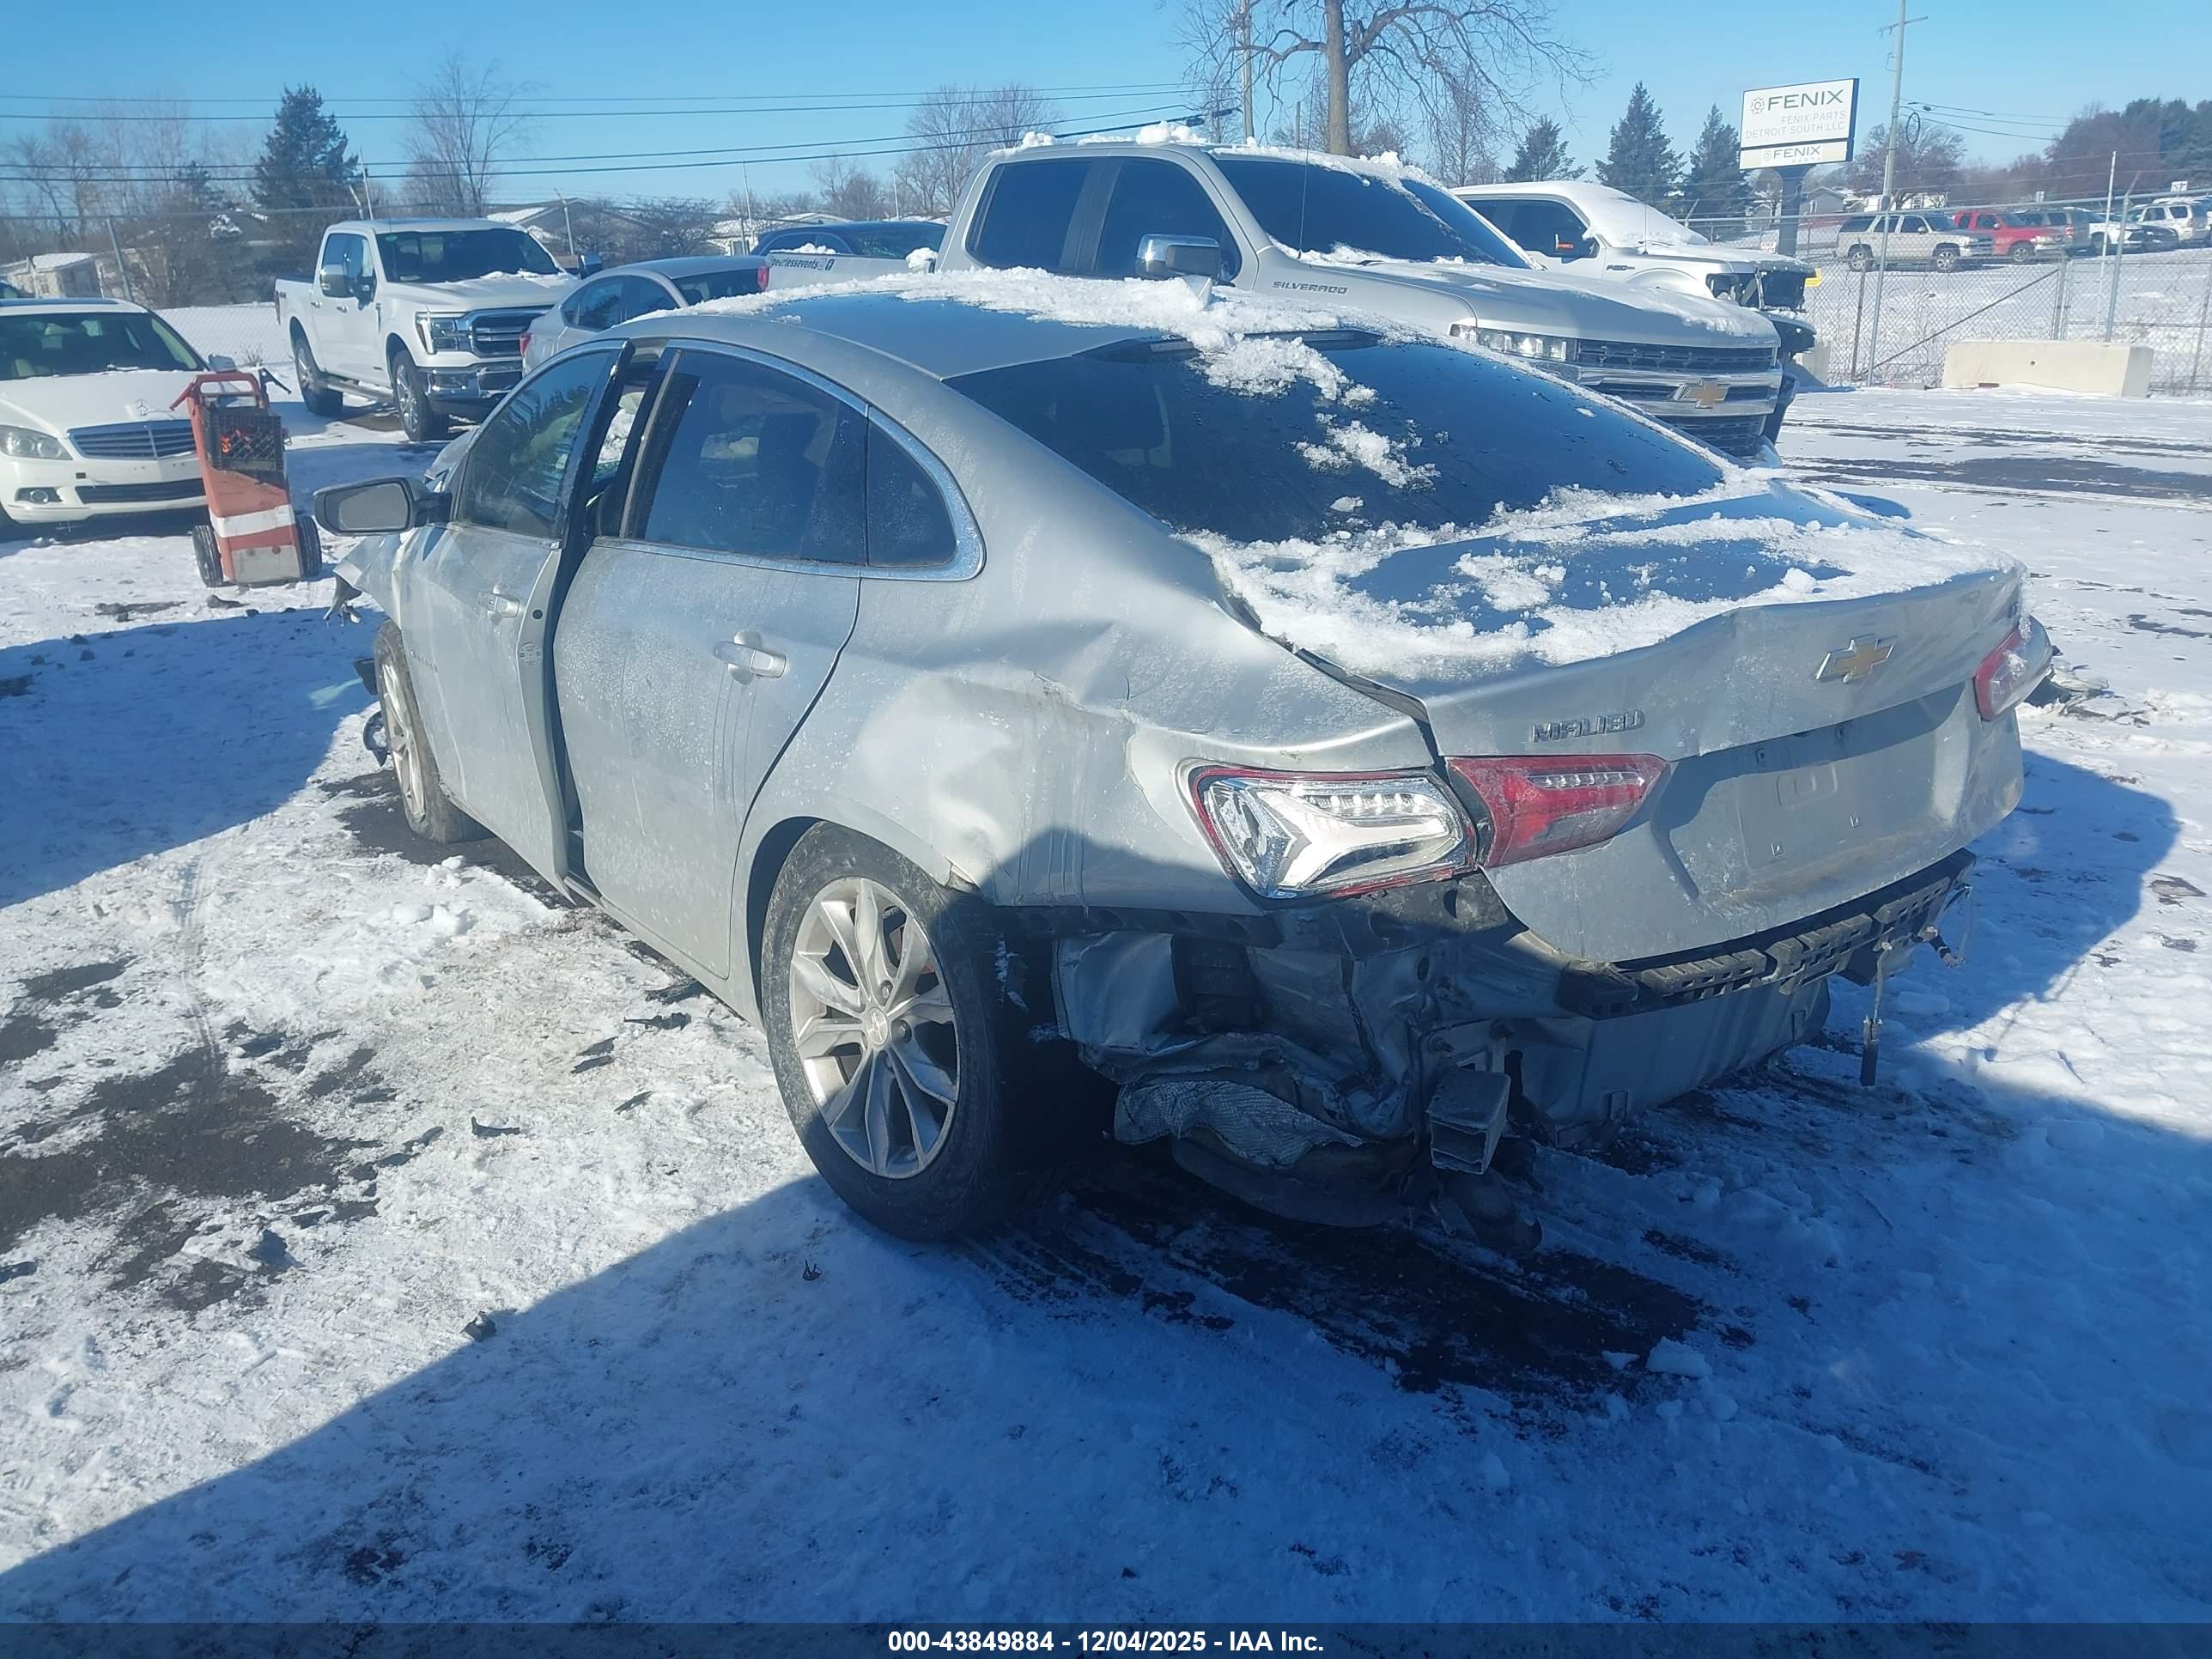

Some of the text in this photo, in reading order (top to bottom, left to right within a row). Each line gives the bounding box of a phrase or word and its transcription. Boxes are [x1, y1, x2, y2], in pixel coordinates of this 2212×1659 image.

[1767, 89, 1844, 111] FENIX
[1781, 111, 1846, 125] FENIX PARTS
[1746, 121, 1845, 139] DETROIT SOUTH LLC
[1773, 145, 1821, 159] FENIX
[1272, 281, 1348, 295] SILVERADO
[1532, 709, 1645, 743] MALIBU
